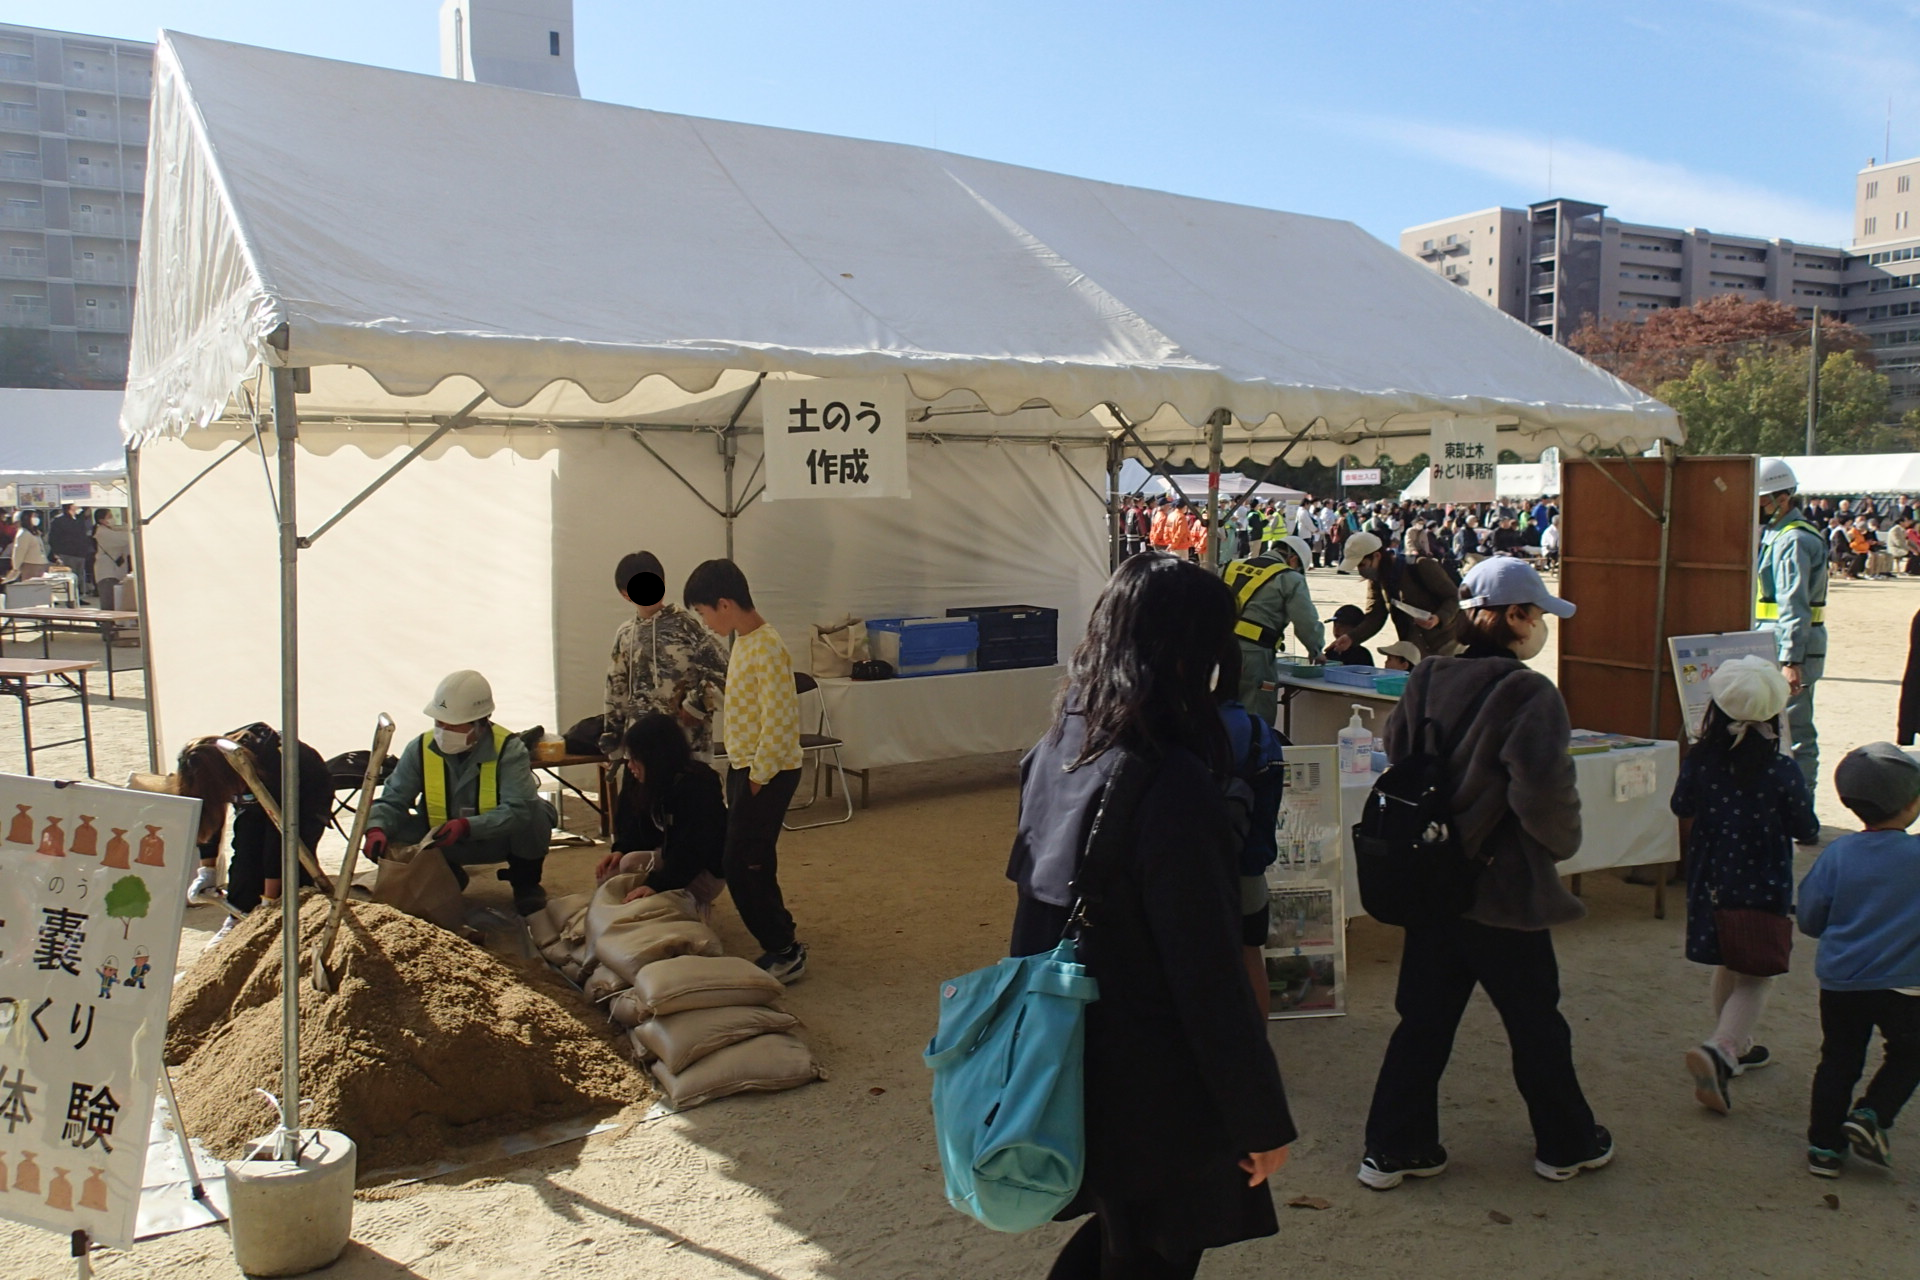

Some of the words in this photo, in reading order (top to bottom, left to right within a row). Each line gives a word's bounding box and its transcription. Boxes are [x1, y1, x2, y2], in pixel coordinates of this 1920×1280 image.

[788, 398, 881, 434] 土のう
[1445, 442, 1484, 459] 東部土木
[806, 448, 869, 485] 作成
[1434, 463, 1493, 479] みどり事務所
[48, 876, 88, 900] のう
